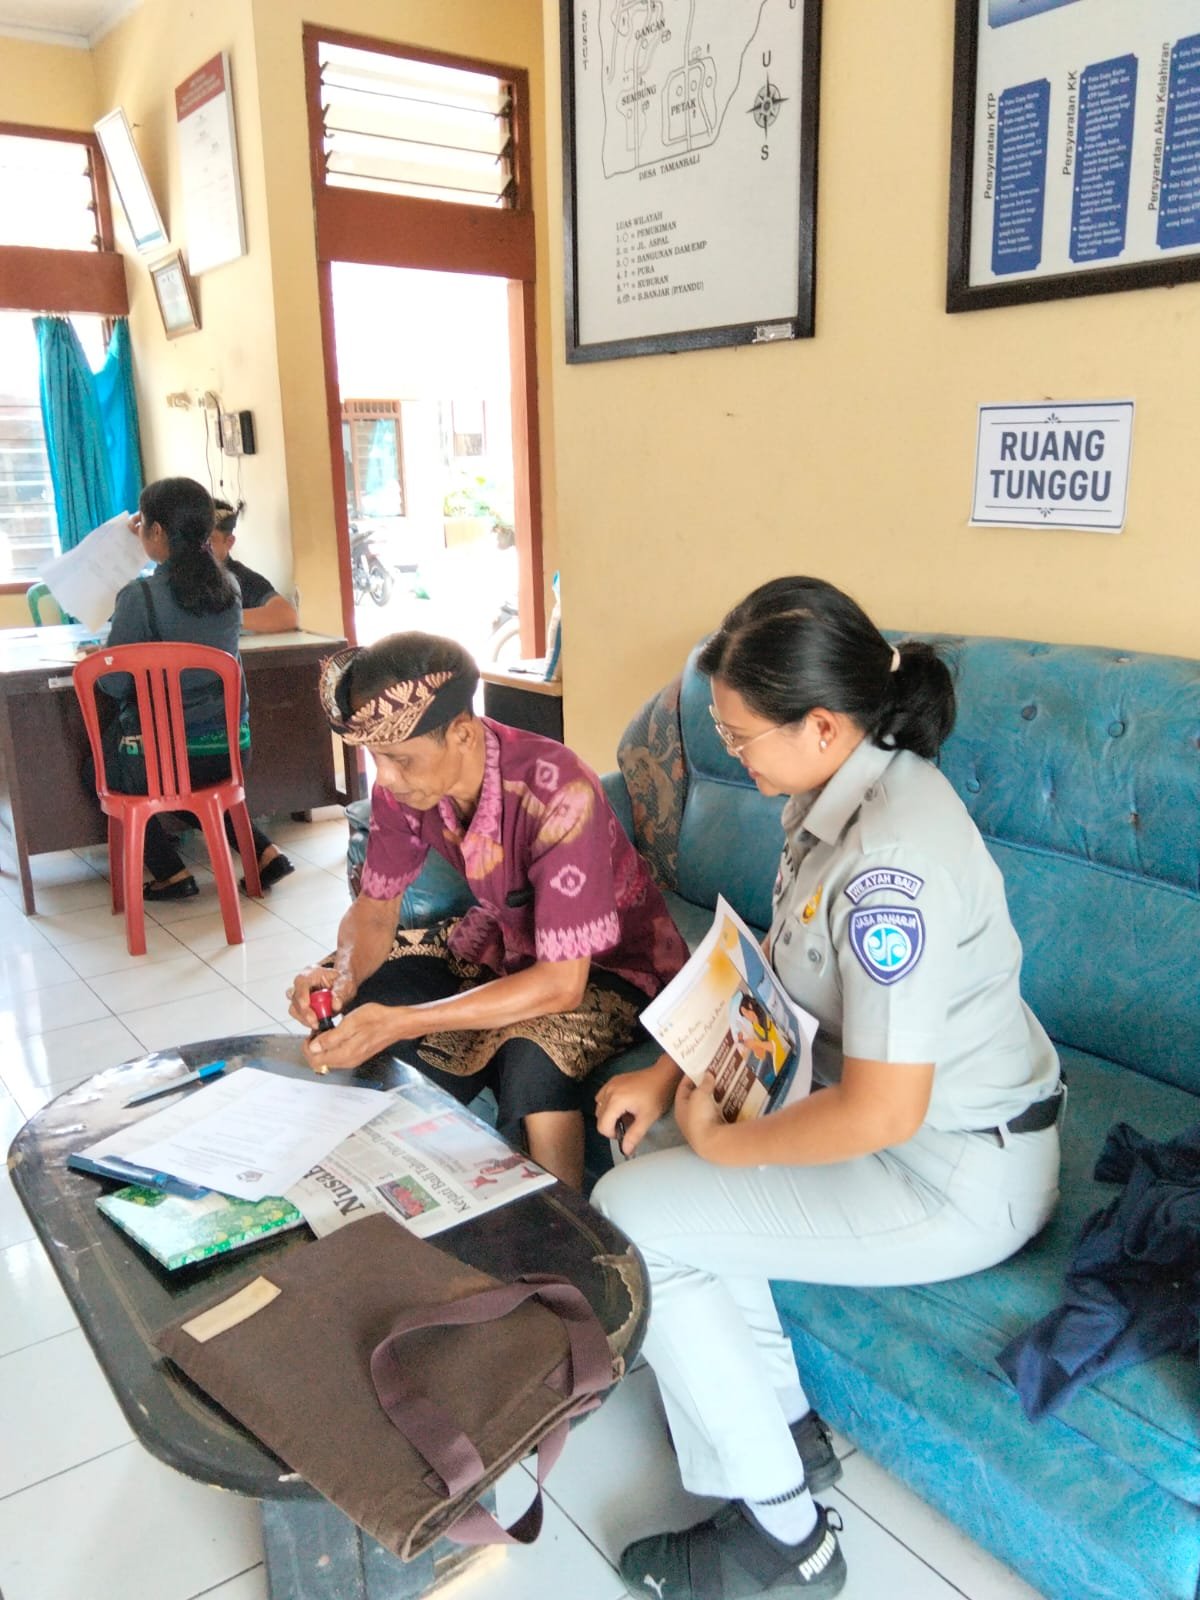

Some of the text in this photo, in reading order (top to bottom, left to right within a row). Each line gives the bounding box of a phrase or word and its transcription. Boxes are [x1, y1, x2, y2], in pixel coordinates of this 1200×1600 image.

[762, 50, 771, 67] U
[622, 85, 656, 106] SEMBUNG
[671, 98, 696, 116] PETAK
[1063, 70, 1077, 175] Persyaratan KK
[1147, 42, 1169, 211] Persyaratan Akta Kelahiran
[760, 145, 769, 160] S
[984, 92, 996, 199] Persyaratan KTP
[637, 221, 677, 238] PEMUKIMAN
[637, 265, 655, 276] PURA
[638, 275, 669, 288] KUBURAN
[1000, 429, 1105, 462] RUANG
[990, 469, 1112, 502] TUNGGU
[851, 873, 917, 898] WILAYAH BALI
[855, 914, 877, 928] JASA
[798, 1529, 836, 1581] PUMA
